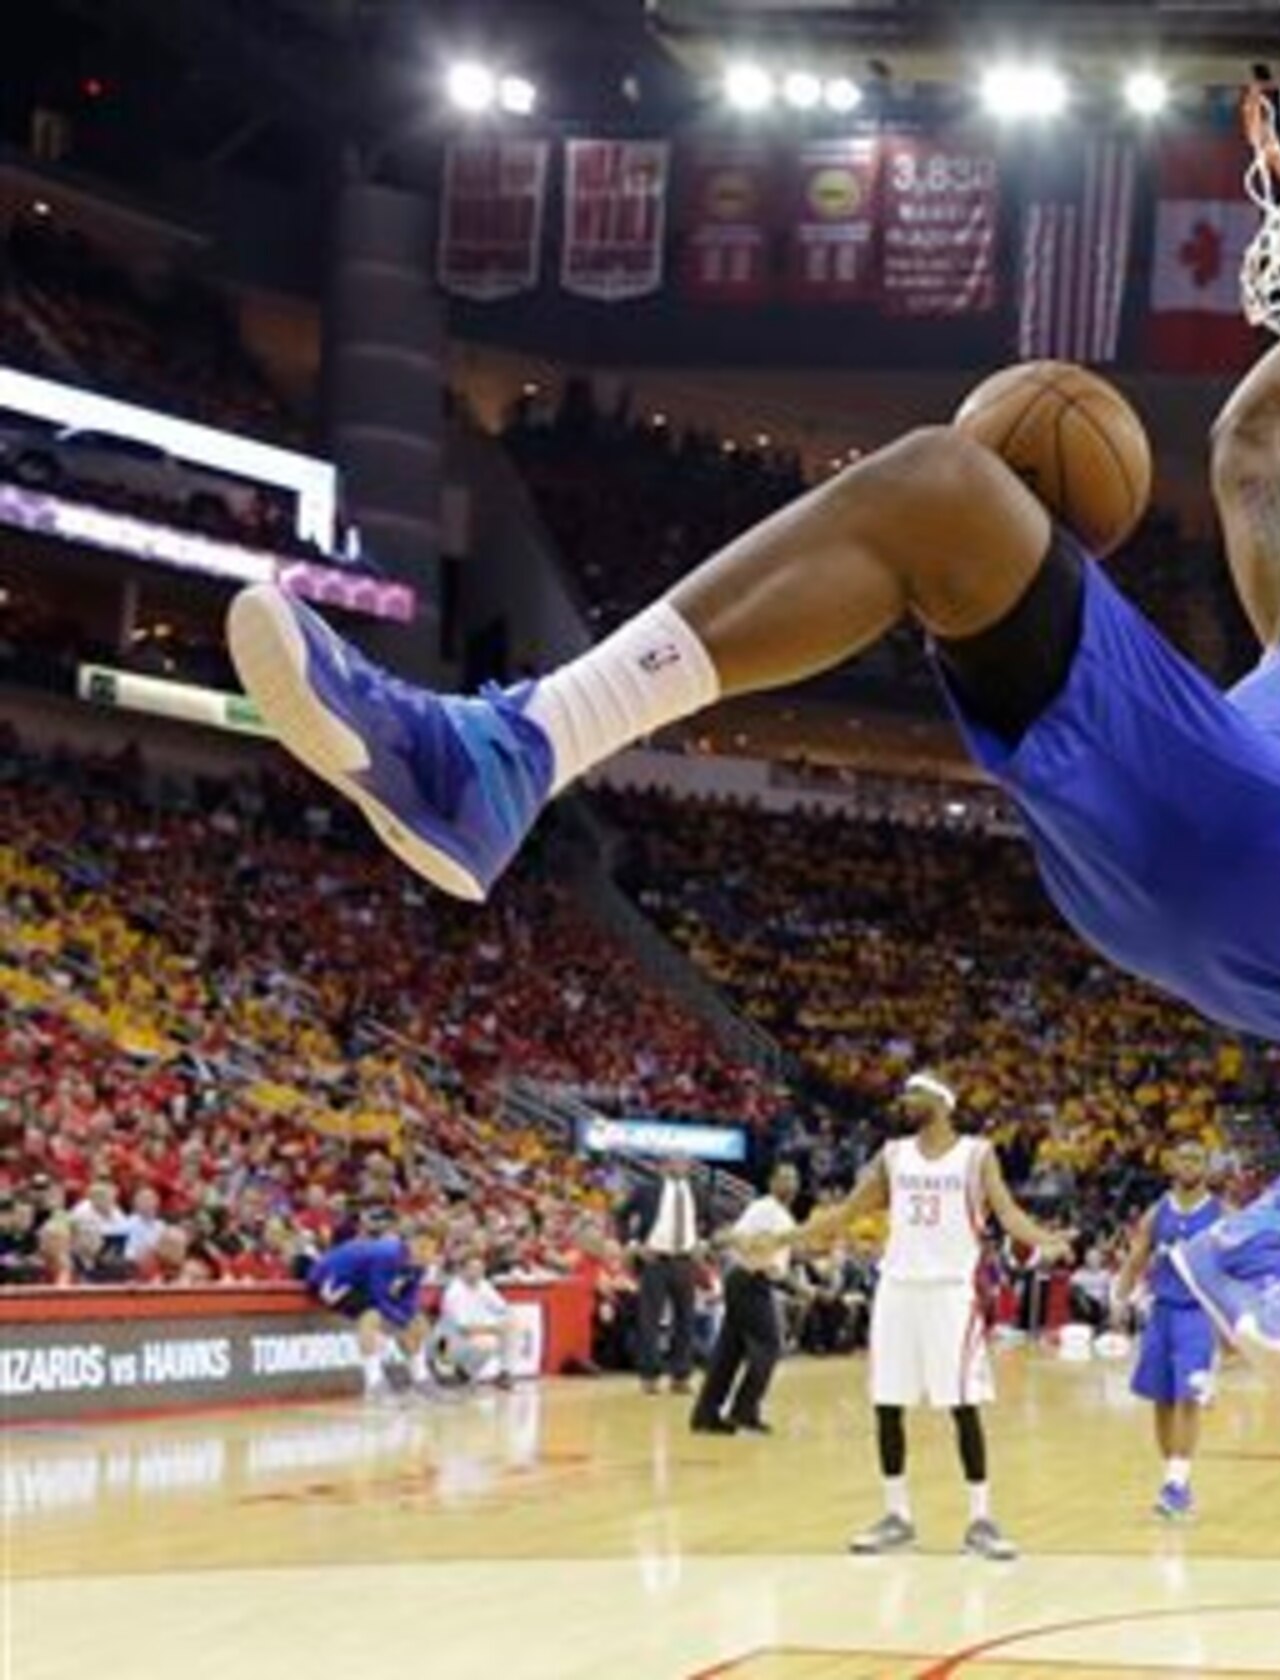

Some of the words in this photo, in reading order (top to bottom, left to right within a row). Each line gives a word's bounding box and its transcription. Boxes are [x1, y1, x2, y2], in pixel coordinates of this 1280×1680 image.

[908, 1193, 941, 1227] 33
[0, 1345, 104, 1394] IZARDS
[110, 1354, 137, 1385] vs
[143, 1338, 231, 1382] HAWKS
